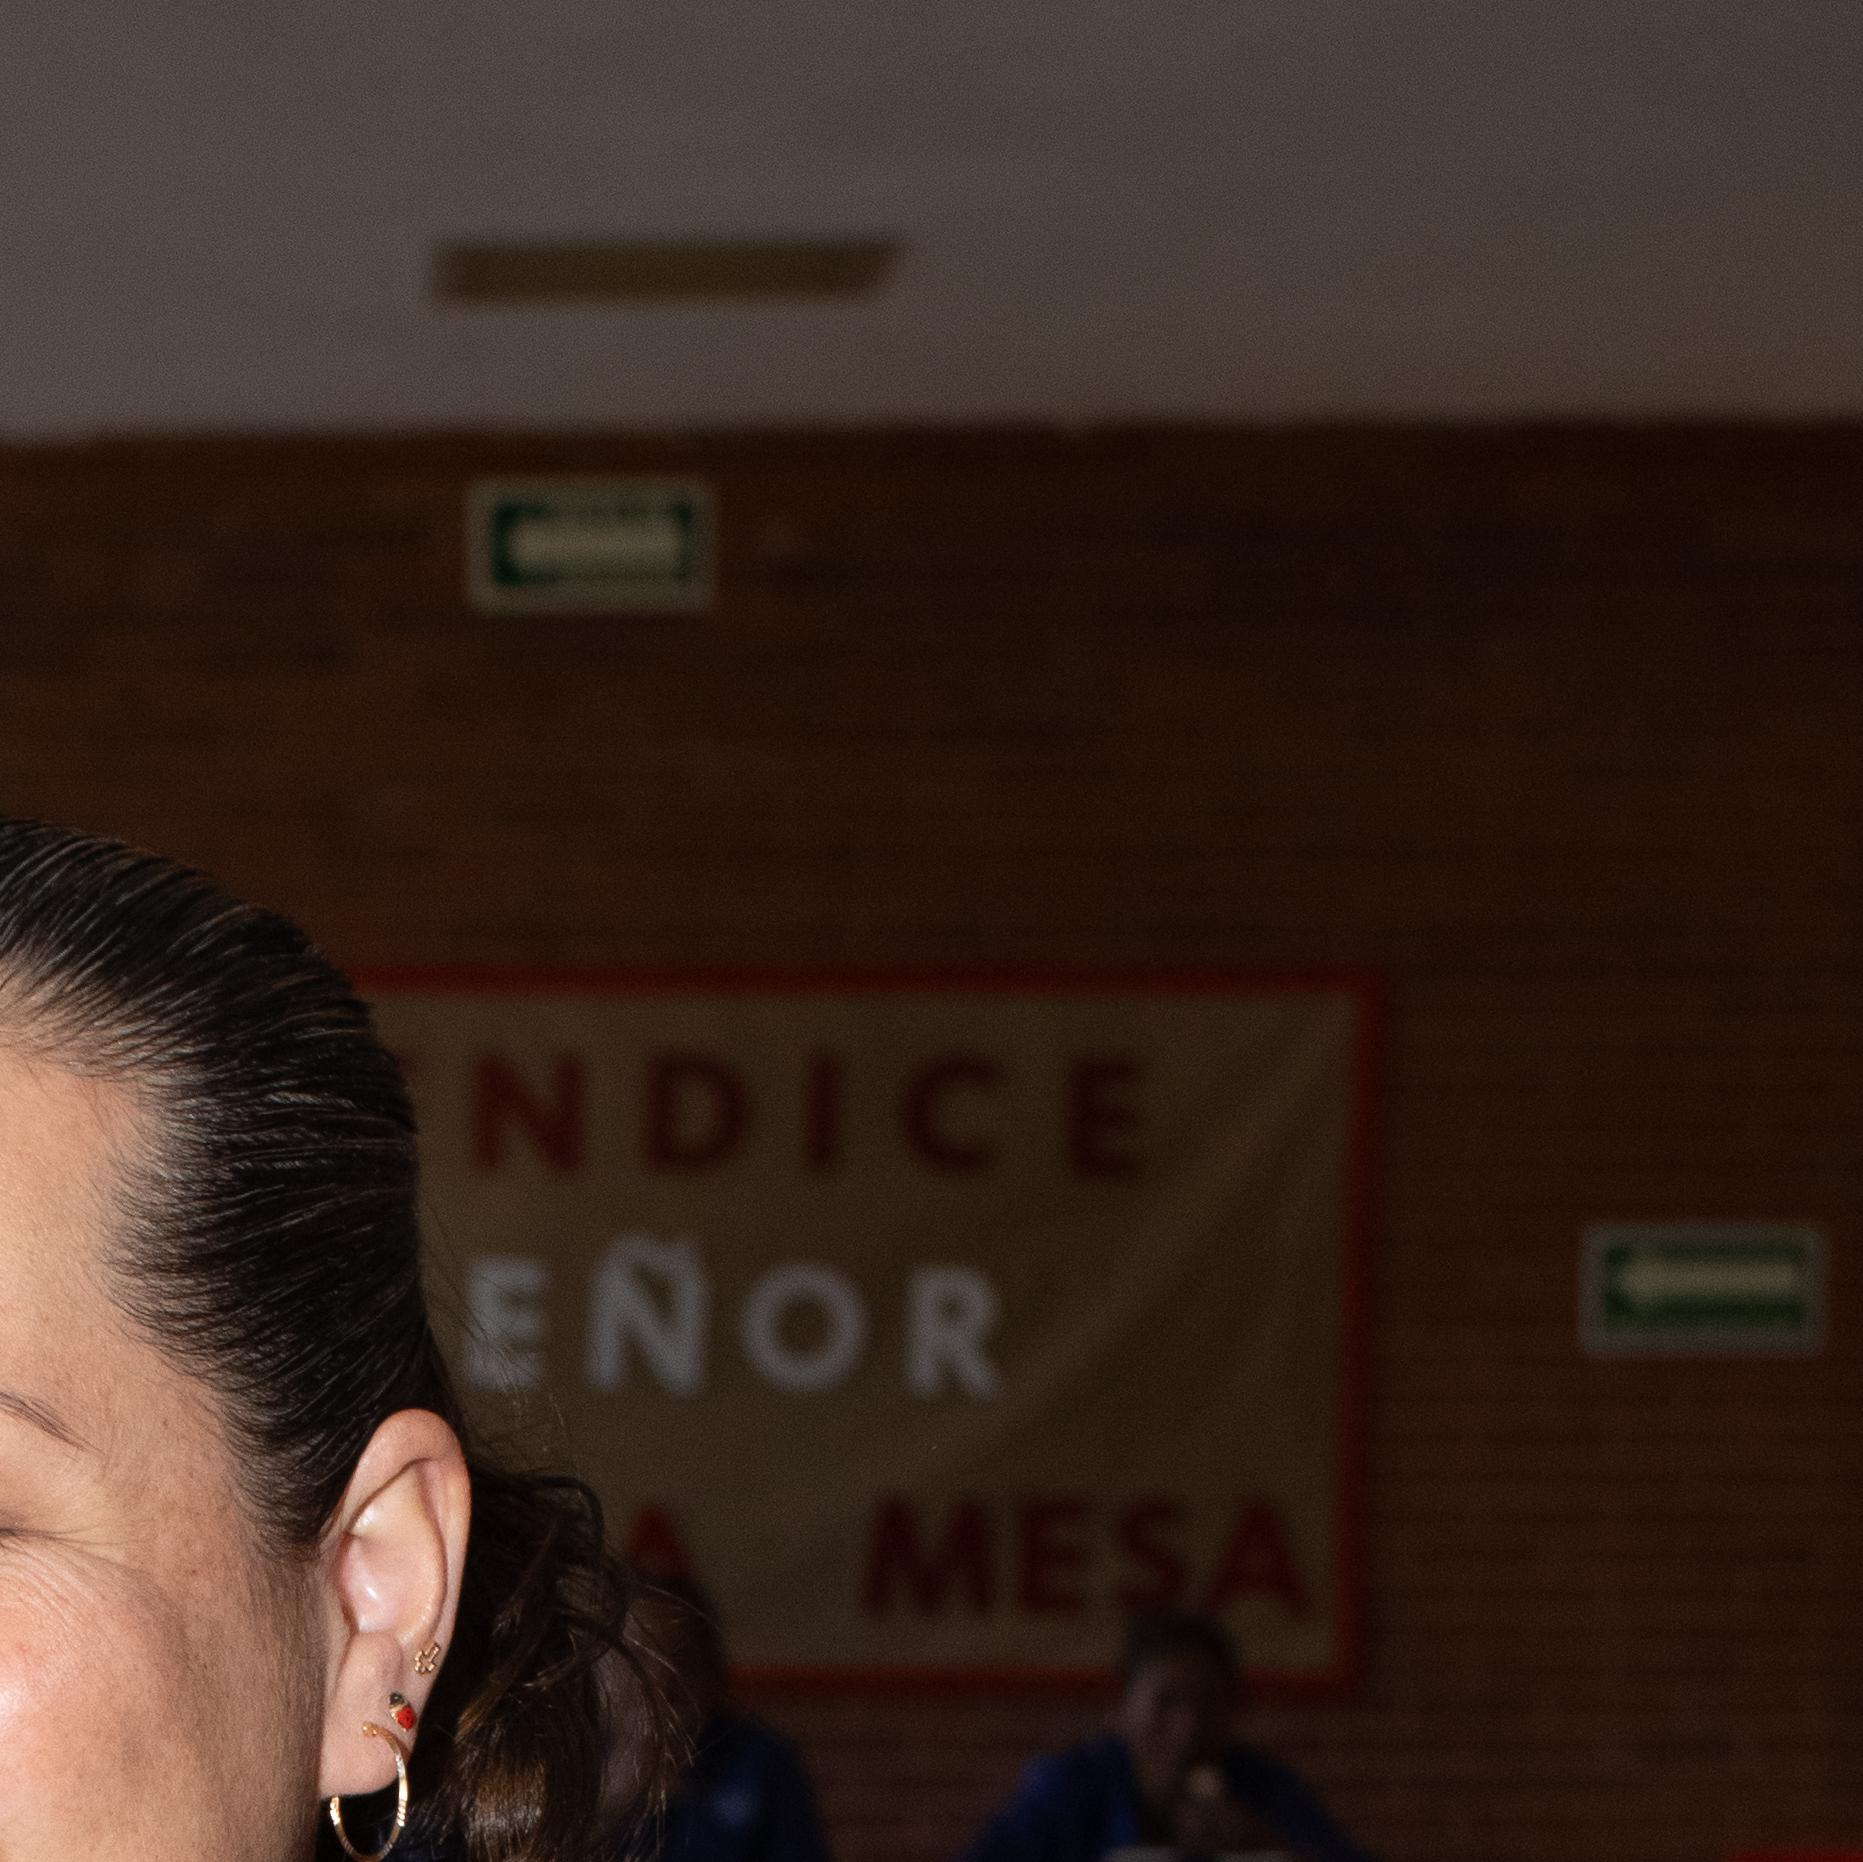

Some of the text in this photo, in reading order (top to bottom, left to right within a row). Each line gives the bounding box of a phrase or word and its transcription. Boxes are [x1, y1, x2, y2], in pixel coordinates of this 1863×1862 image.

[404, 1050, 1148, 1182] NDICE
[464, 1231, 1002, 1398] EÑOR
[858, 1492, 1312, 1621] MESA
